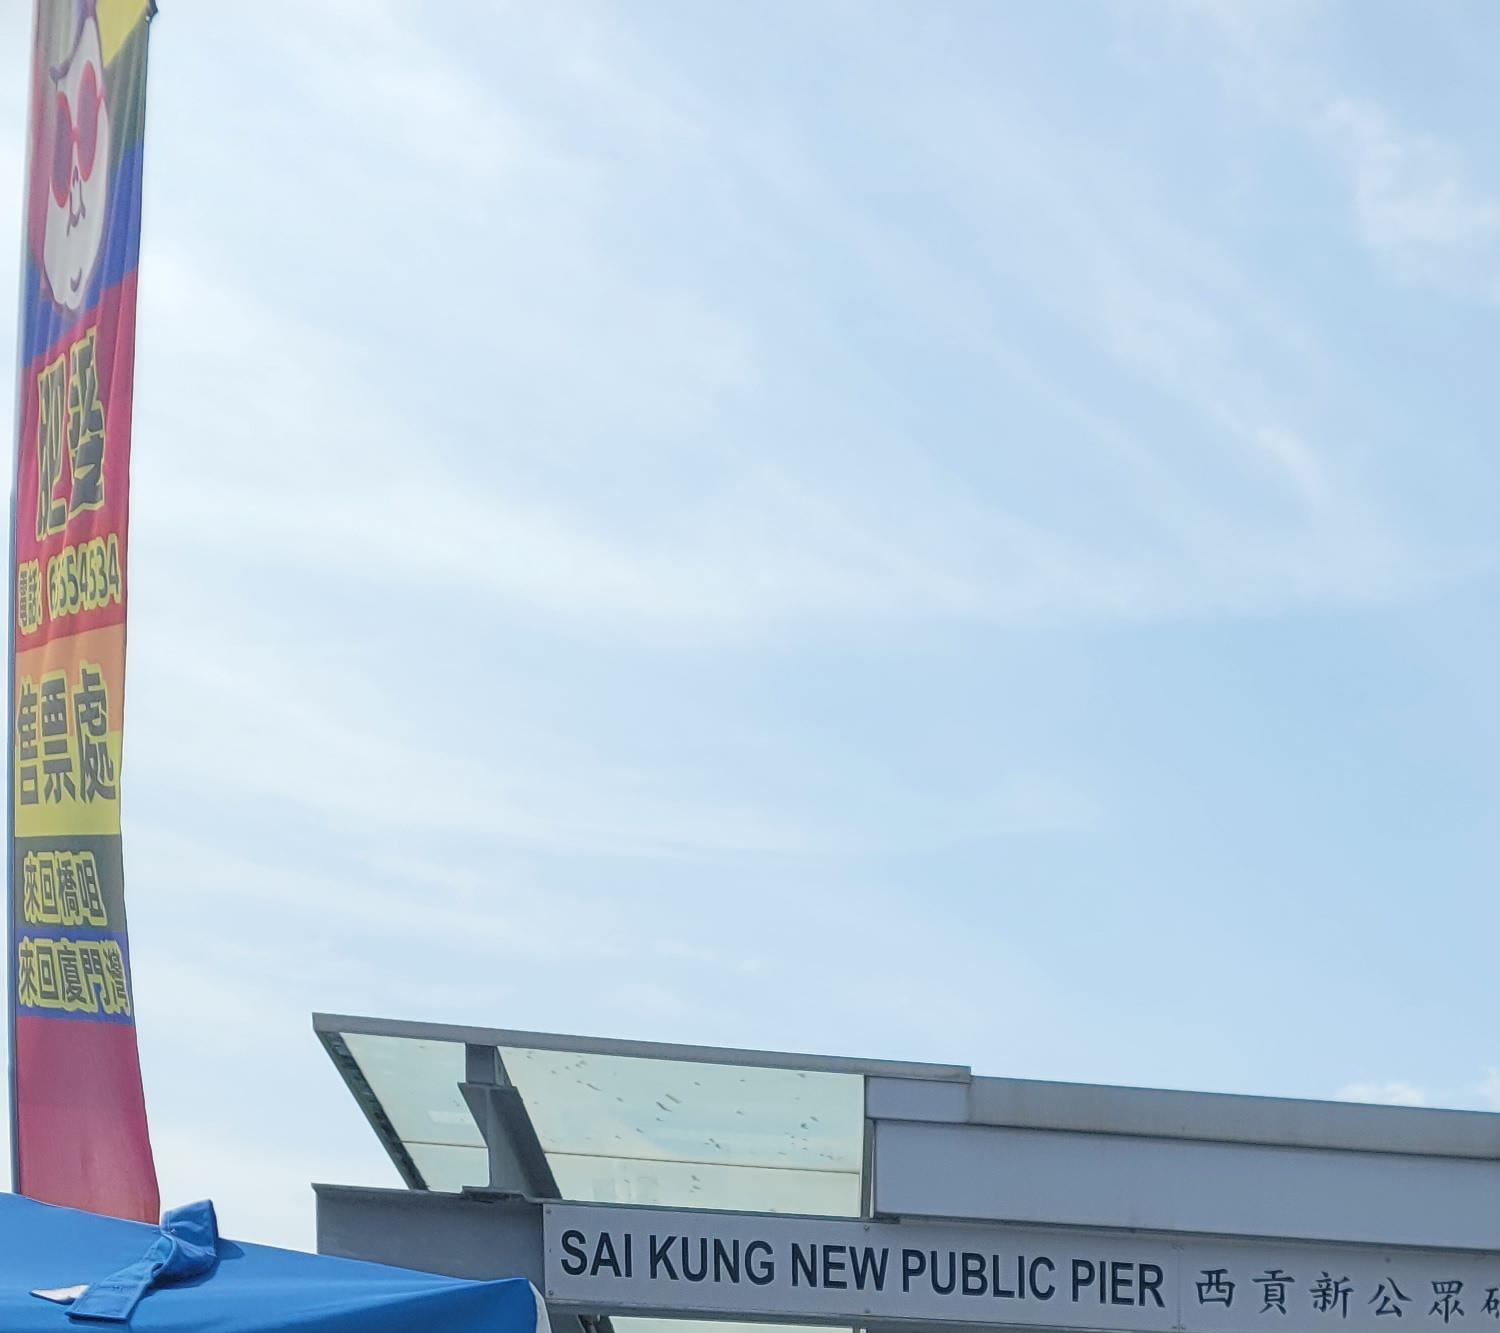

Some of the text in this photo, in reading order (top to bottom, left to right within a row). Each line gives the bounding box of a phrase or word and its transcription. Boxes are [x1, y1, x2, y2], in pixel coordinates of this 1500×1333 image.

[17, 660, 117, 807] 售票處
[560, 1229, 1165, 1308] SAI KUNG NEW PUBLIC PIER
